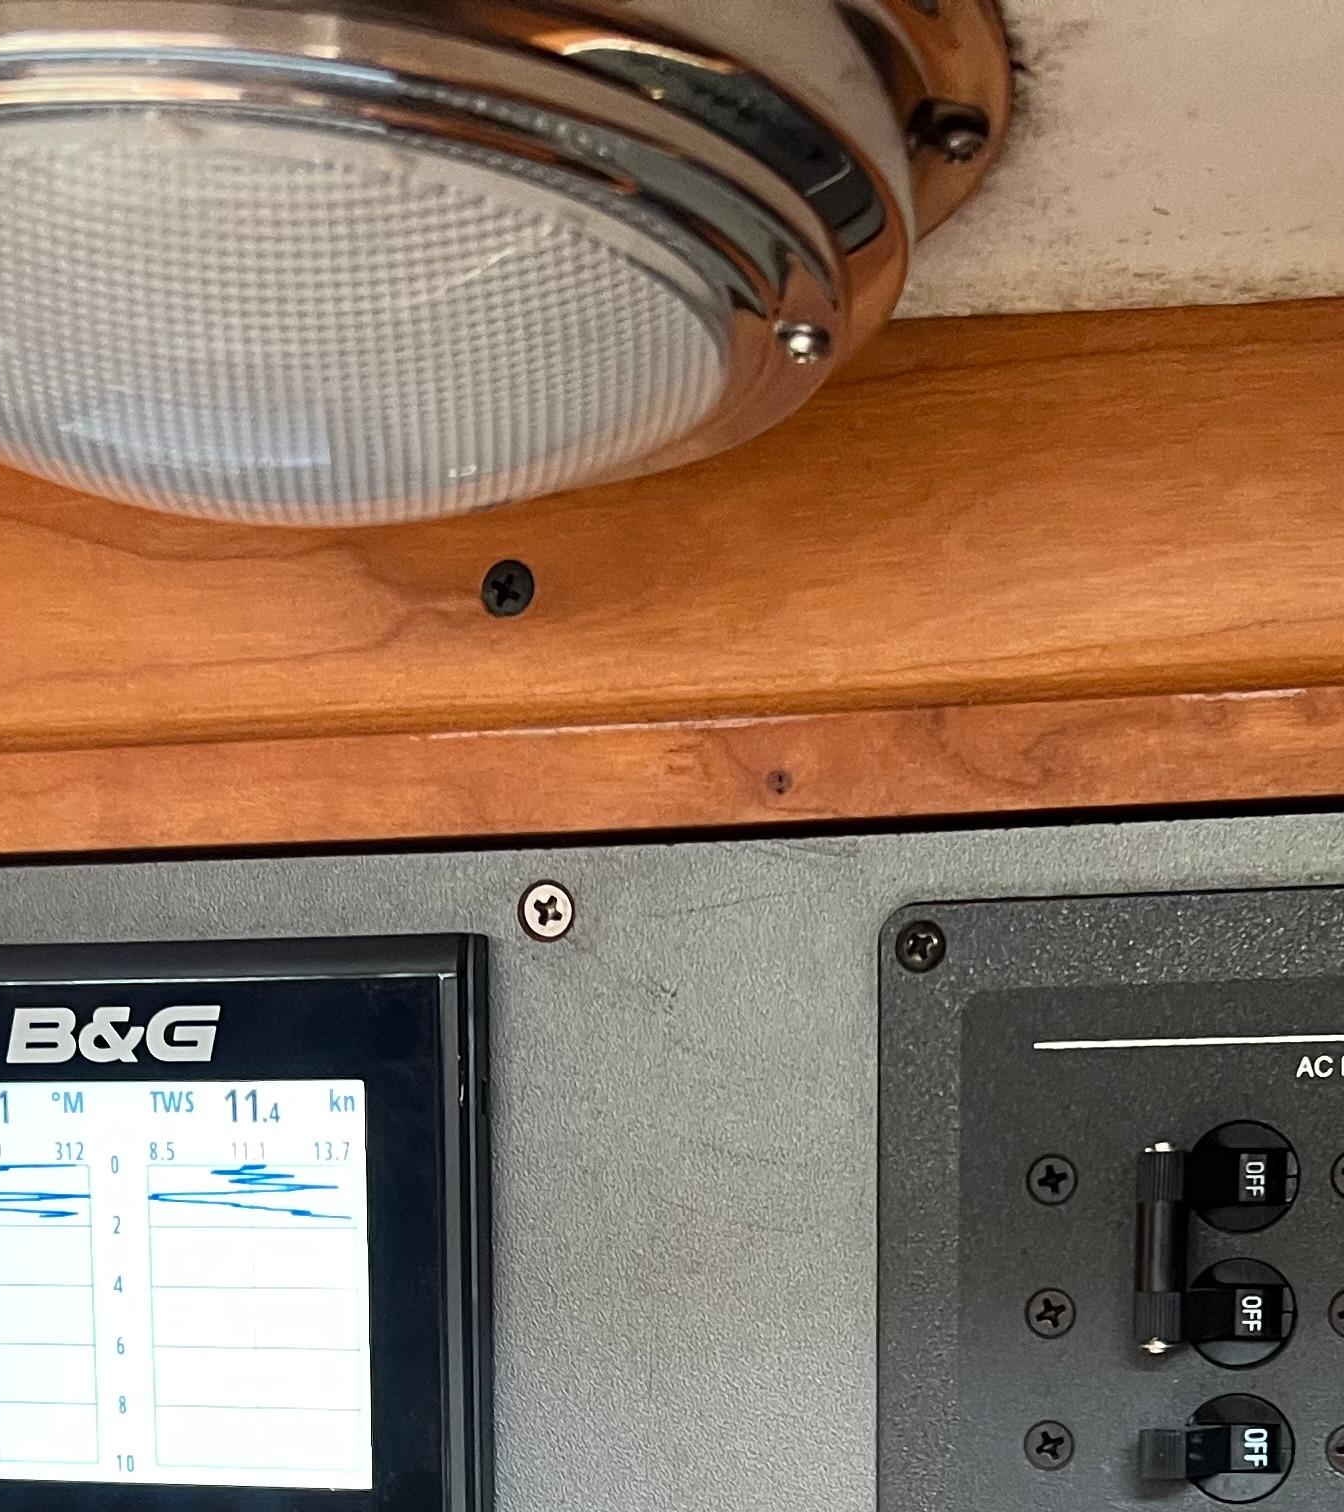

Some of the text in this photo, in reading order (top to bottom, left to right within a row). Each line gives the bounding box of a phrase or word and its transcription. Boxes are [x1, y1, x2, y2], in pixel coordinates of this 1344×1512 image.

[6, 1005, 221, 1063] B&G
[1296, 1054, 1334, 1078] AC
[51, 1092, 84, 1113] °M
[150, 1091, 194, 1113] TWS
[224, 1089, 280, 1123] 11.4
[330, 1090, 355, 1112] kn
[55, 1142, 84, 1161] 312
[149, 1142, 174, 1161] 8.5
[231, 1142, 266, 1161] 11.1
[314, 1141, 350, 1161] 13.7
[109, 1156, 120, 1174] 0
[1245, 1161, 1265, 1198] OFF
[112, 1216, 121, 1235] 2
[113, 1276, 123, 1294] 4
[1241, 1295, 1262, 1332] OFF
[115, 1336, 125, 1355] 6
[117, 1396, 127, 1414] 8
[1244, 1428, 1268, 1468] OFF
[116, 1454, 135, 1473] 10
